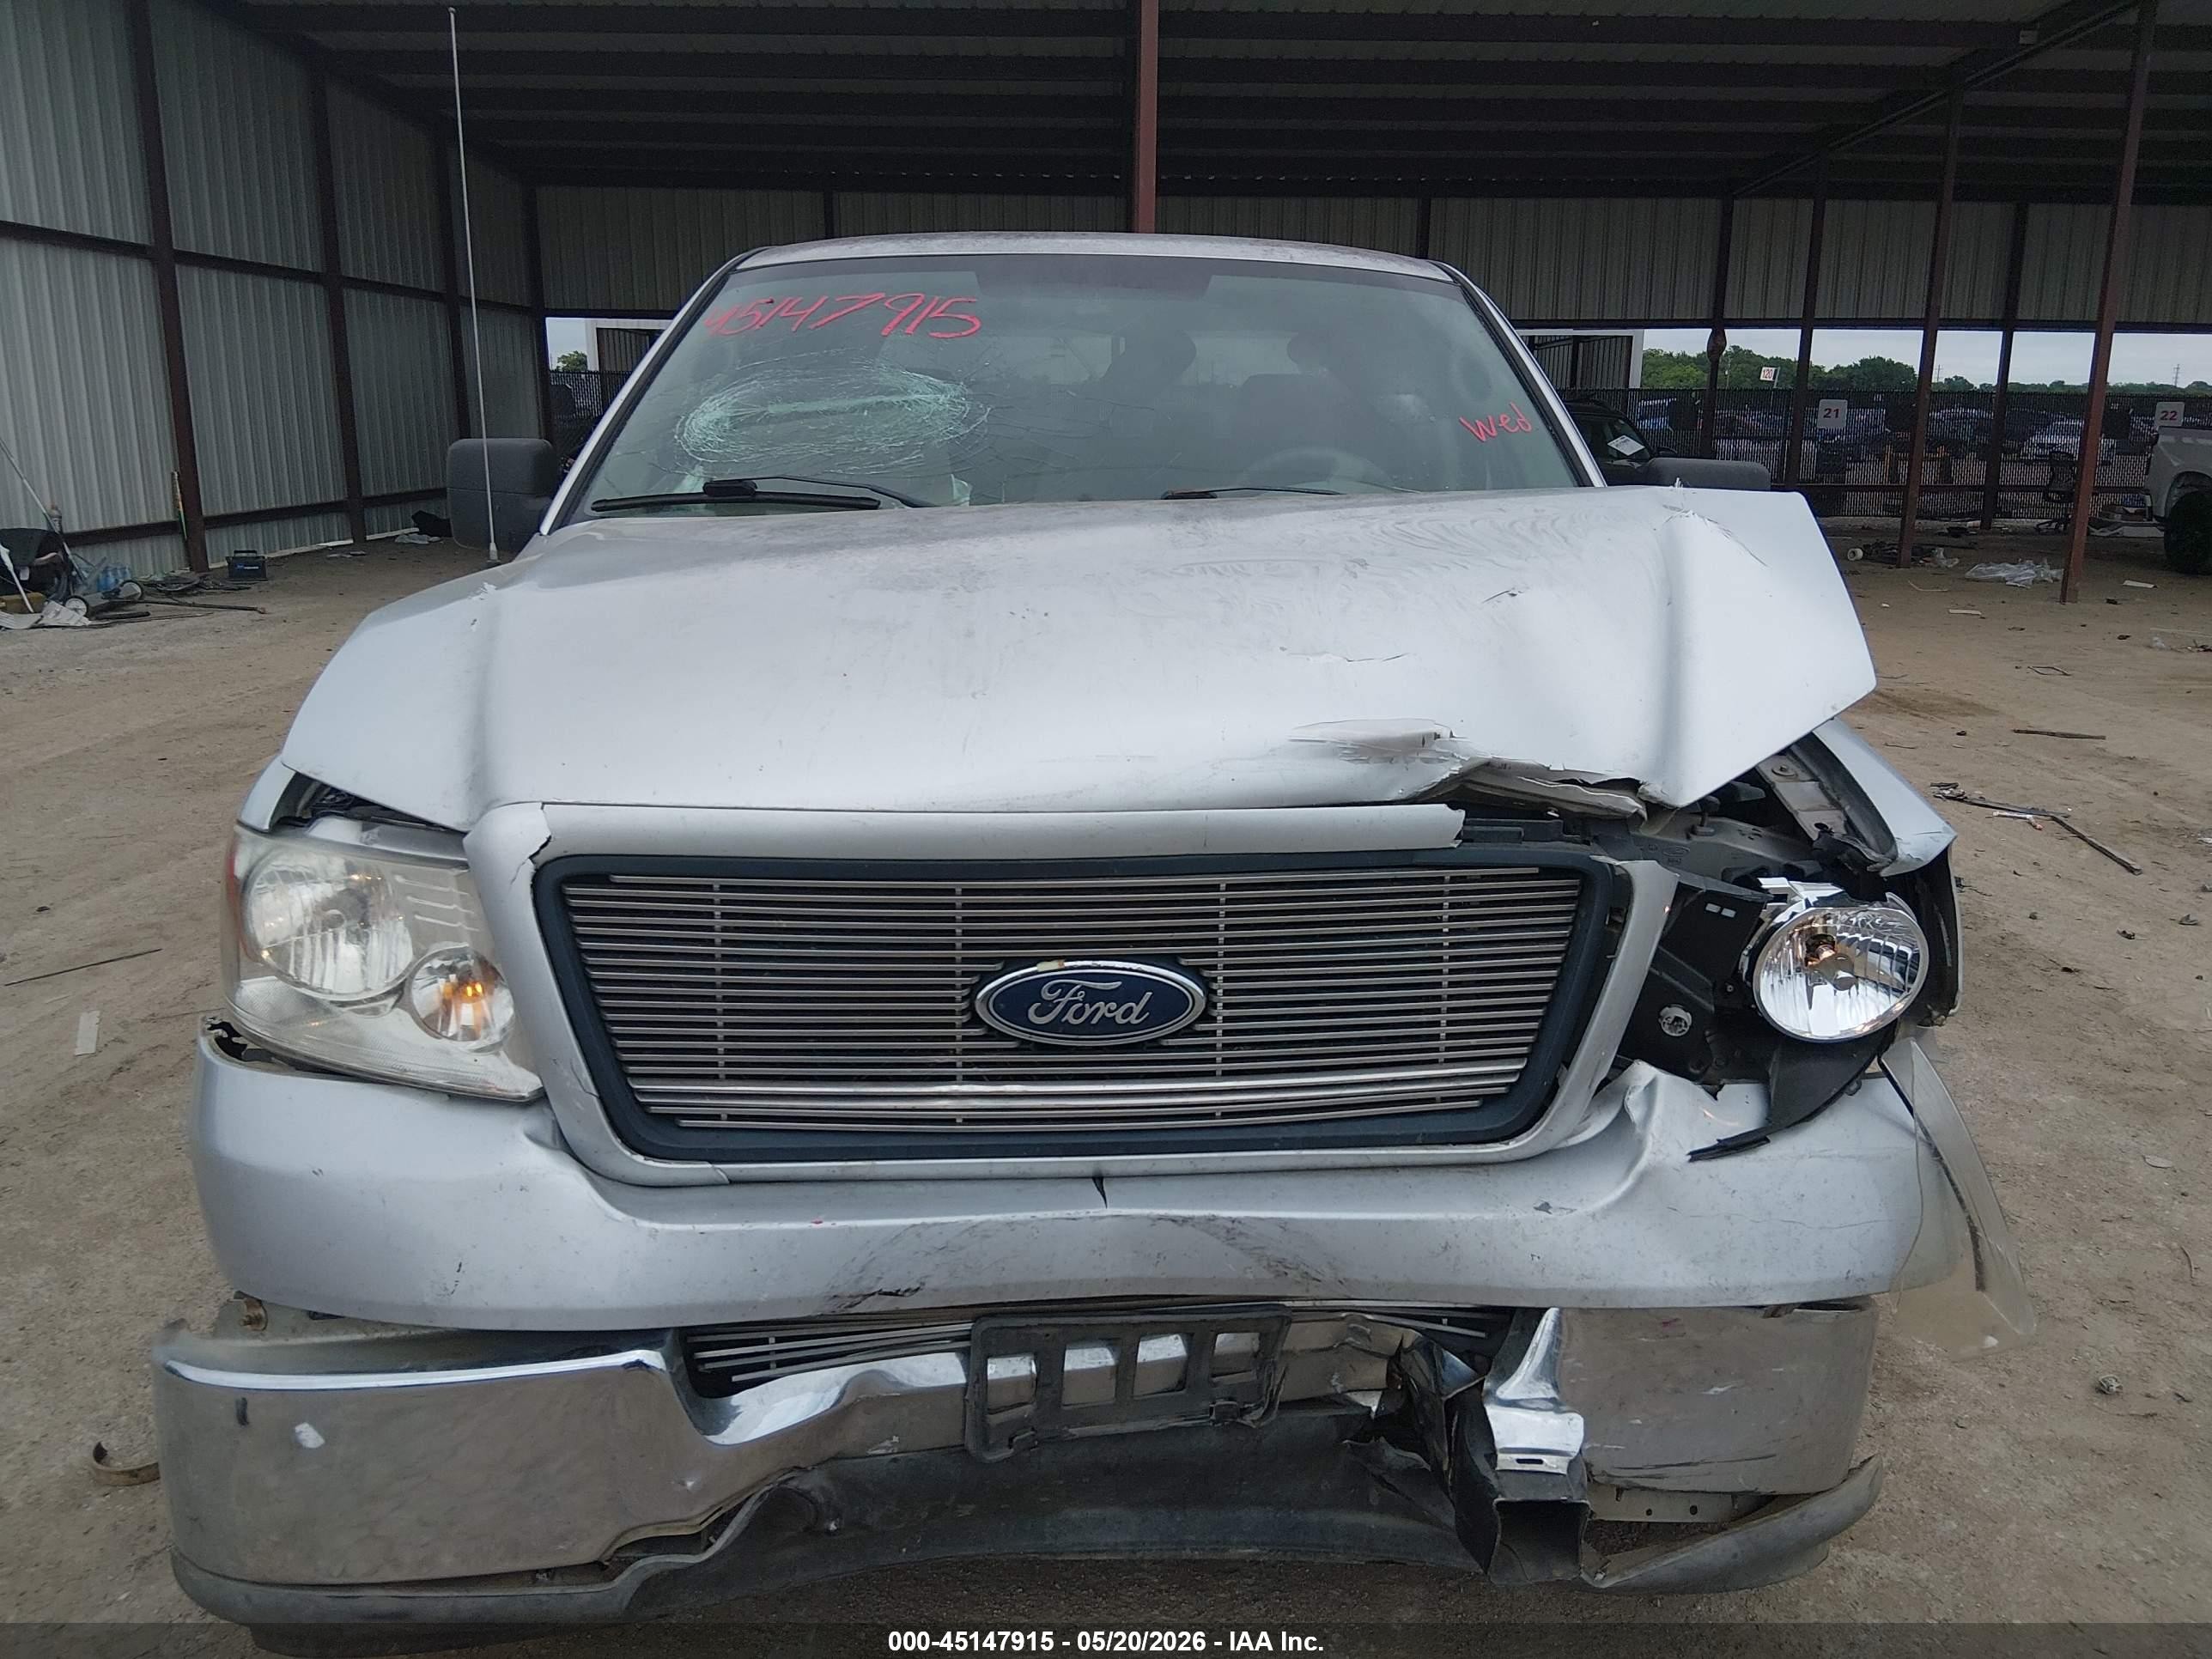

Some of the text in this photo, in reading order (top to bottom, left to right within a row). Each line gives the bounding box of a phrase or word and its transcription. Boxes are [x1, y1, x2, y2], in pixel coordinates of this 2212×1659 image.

[703, 292, 982, 339] 45147915
[1762, 368, 1773, 380] 120
[1458, 400, 1533, 442] Wed
[1823, 407, 1840, 418] 21
[2160, 410, 2178, 421] 22
[1028, 979, 1152, 1025] Ford
